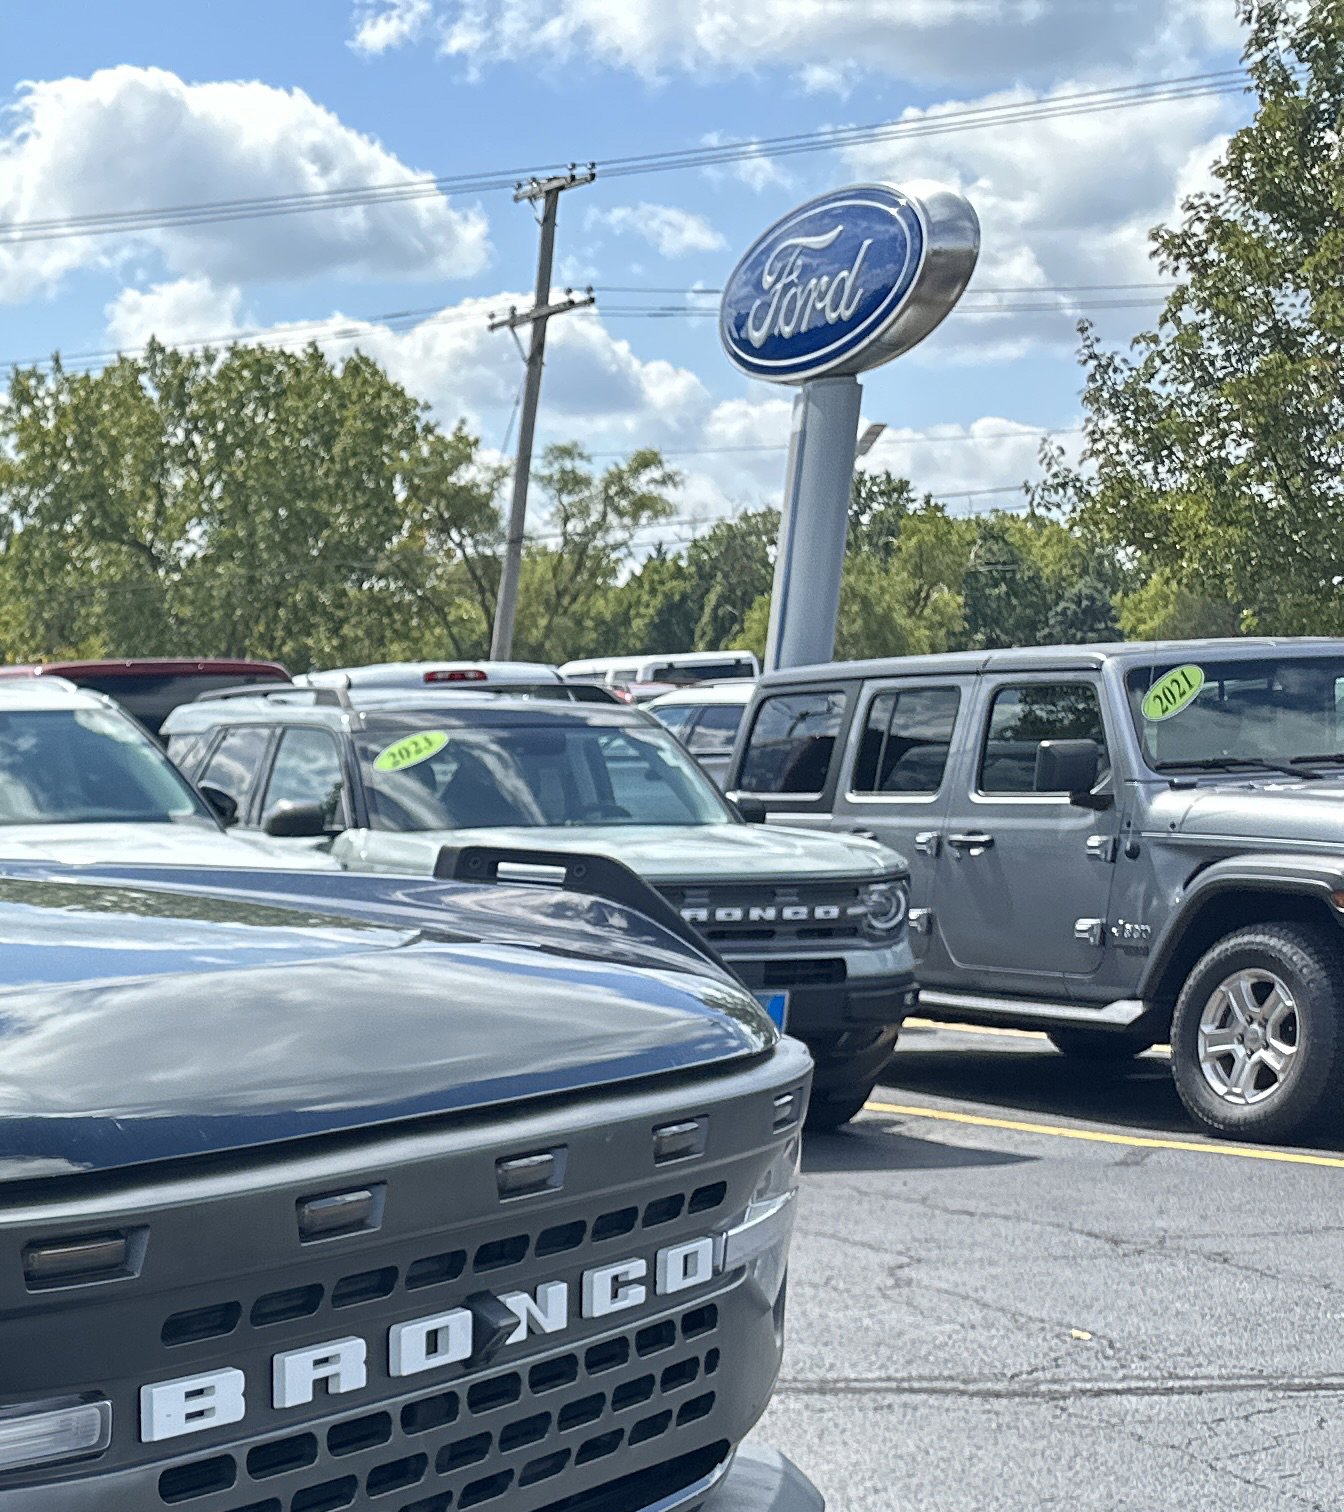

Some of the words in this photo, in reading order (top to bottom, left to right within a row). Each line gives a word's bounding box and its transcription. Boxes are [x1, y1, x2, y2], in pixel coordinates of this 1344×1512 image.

[746, 224, 874, 349] Ford
[1152, 669, 1195, 715] 2021
[679, 905, 840, 922] RONCO
[140, 1236, 713, 1443] BRONCO
